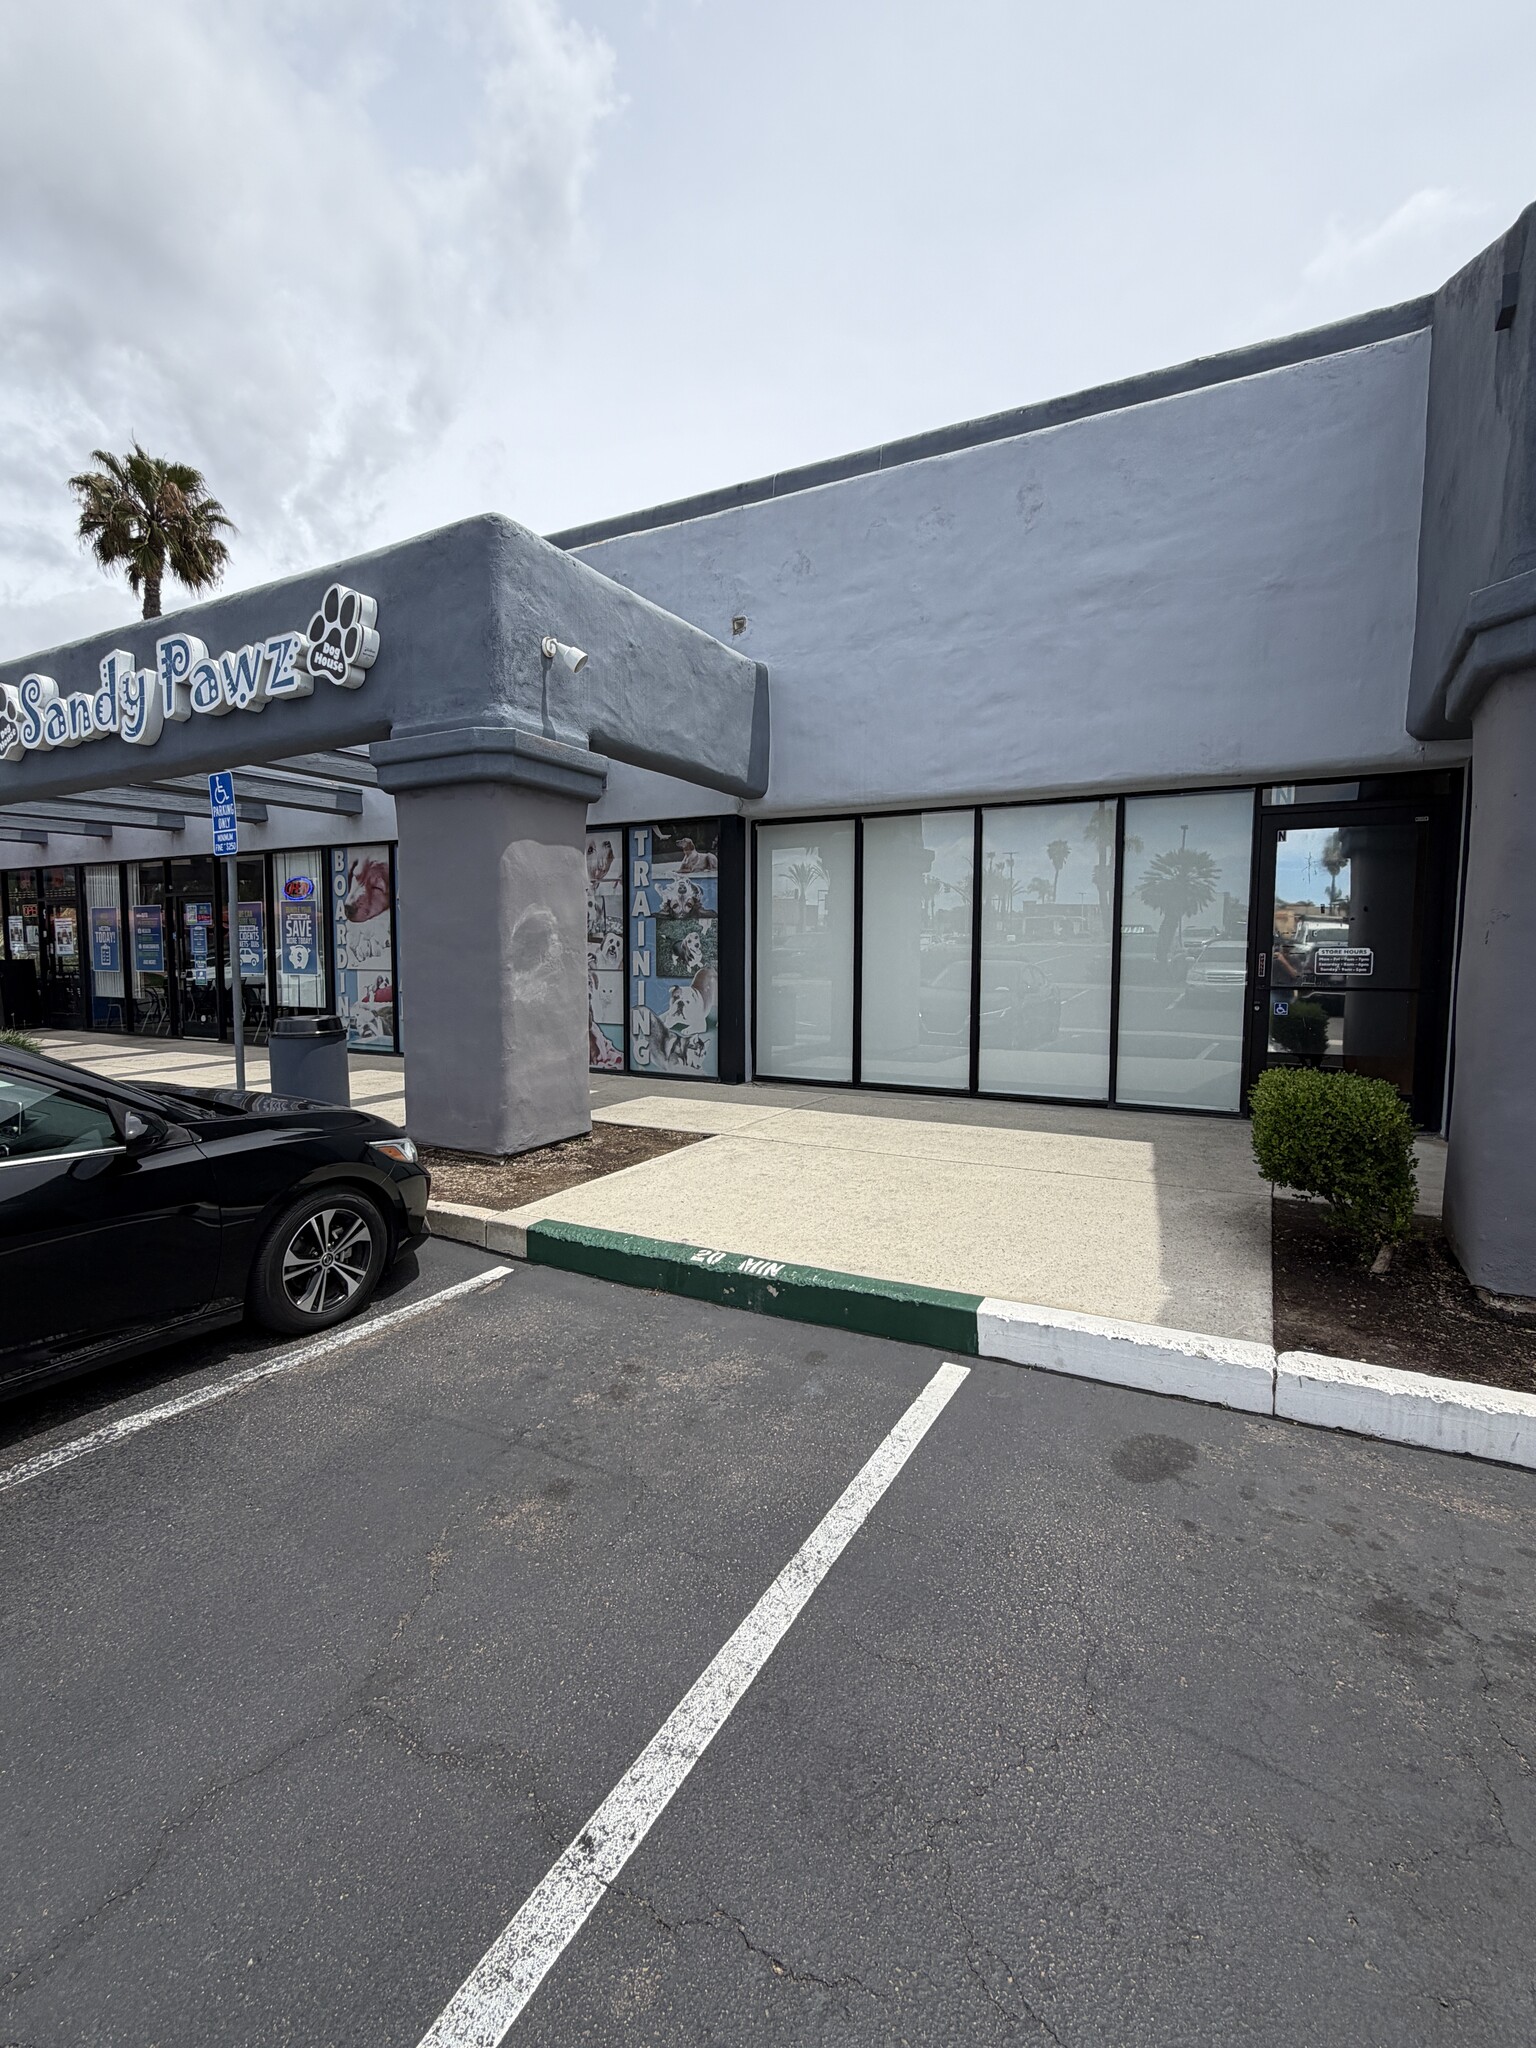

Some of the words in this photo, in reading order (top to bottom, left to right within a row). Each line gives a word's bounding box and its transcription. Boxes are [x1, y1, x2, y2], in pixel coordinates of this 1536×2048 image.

[322, 641, 341, 660] Dog
[313, 651, 344, 673] House
[19, 650, 150, 746] Sandy
[0, 723, 11, 740] Dog
[1275, 787, 1292, 805] N
[213, 803, 234, 817] PARKING
[217, 816, 231, 829] ONLY
[1278, 830, 1287, 842] N
[215, 843, 224, 852] FINE
[95, 931, 116, 943] TODAY!
[285, 920, 312, 937] SAVE
[631, 829, 651, 1065] TRAINING
[690, 1249, 727, 1265] 20
[737, 1257, 786, 1277] MIN
